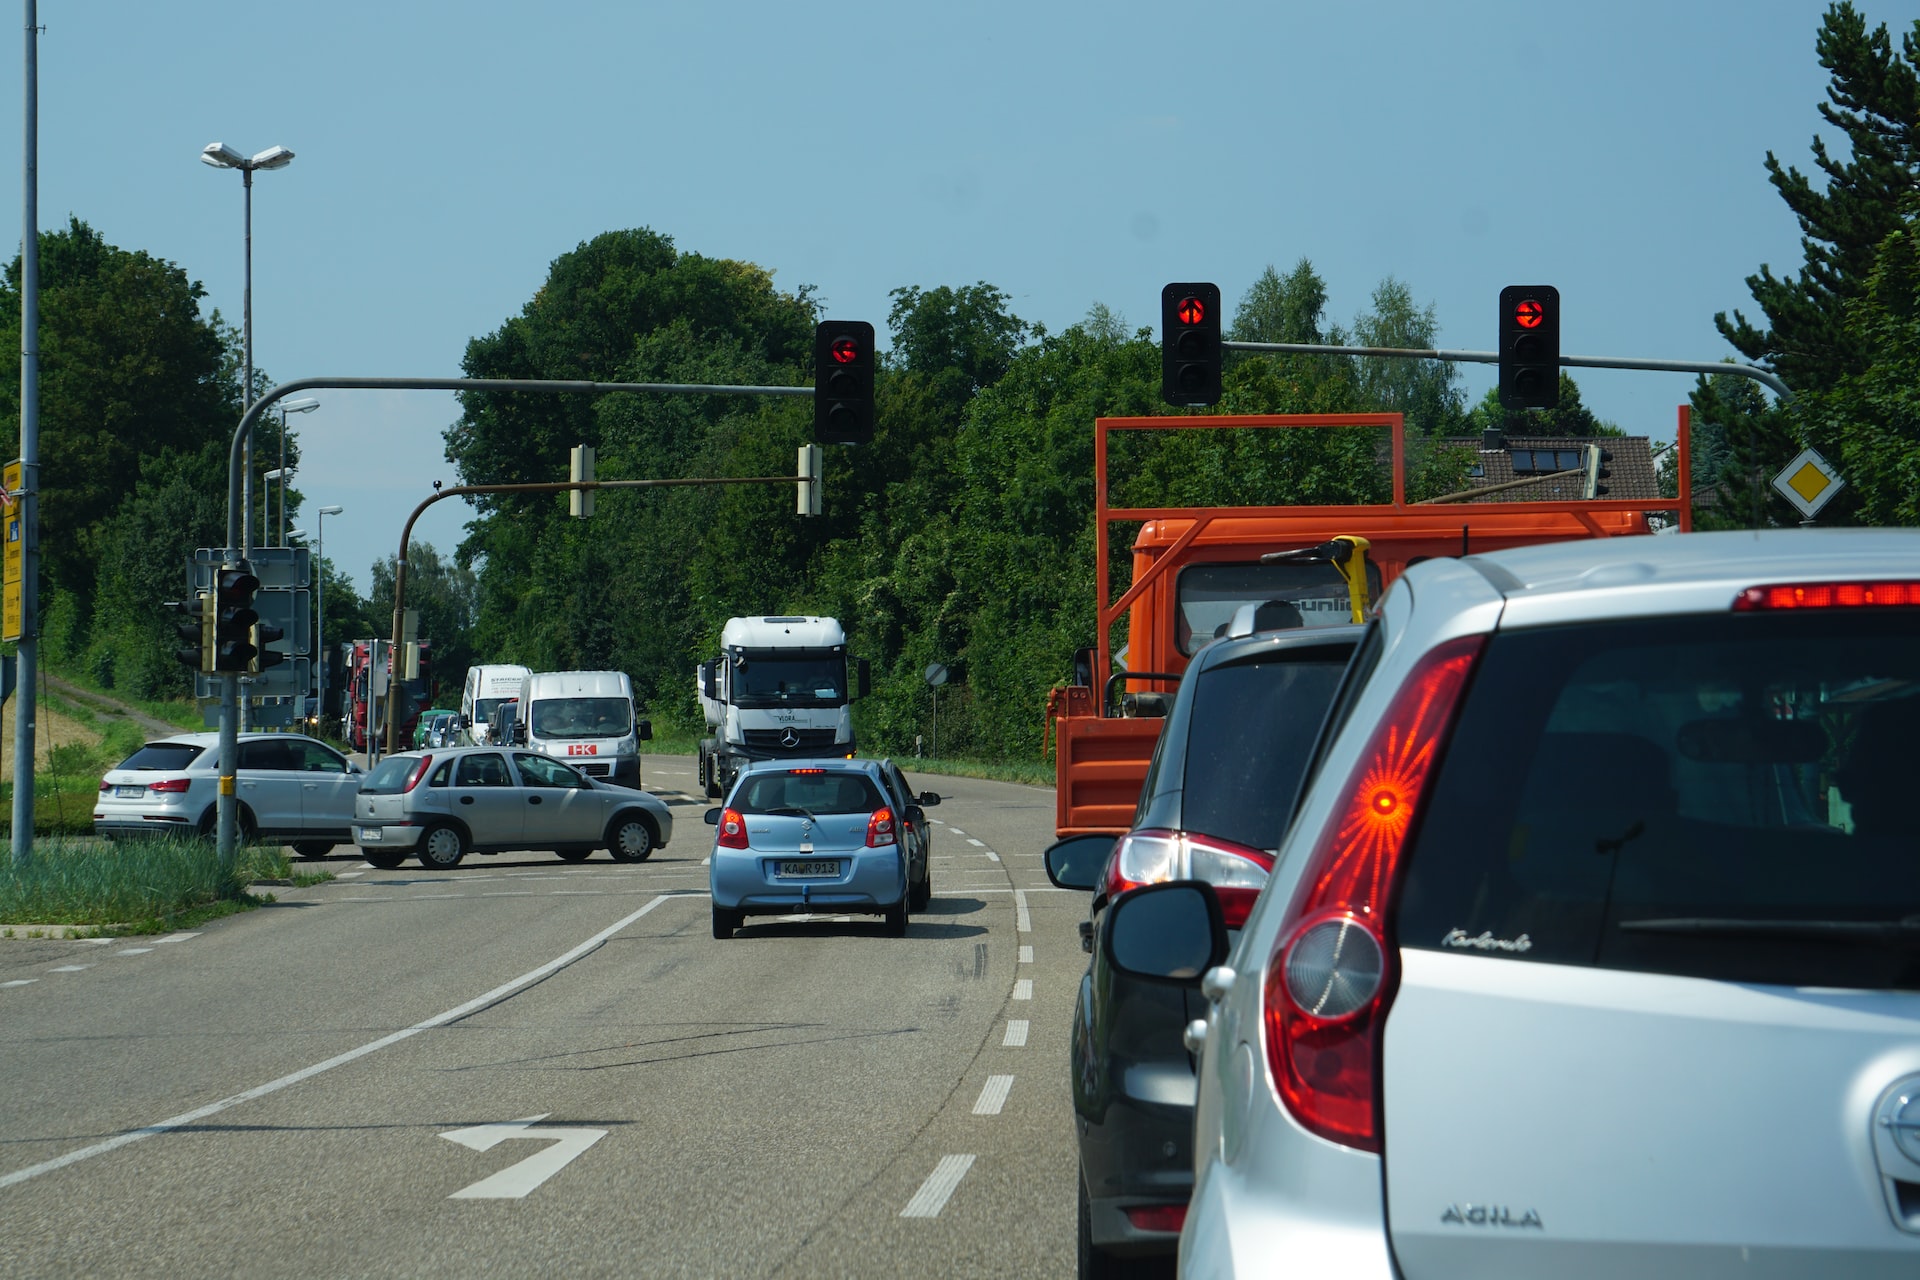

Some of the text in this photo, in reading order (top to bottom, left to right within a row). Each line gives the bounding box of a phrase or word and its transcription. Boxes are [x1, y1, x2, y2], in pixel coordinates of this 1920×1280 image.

[784, 863, 798, 874] KA
[814, 863, 835, 874] 913
[1440, 1202, 1544, 1231] AGILA
